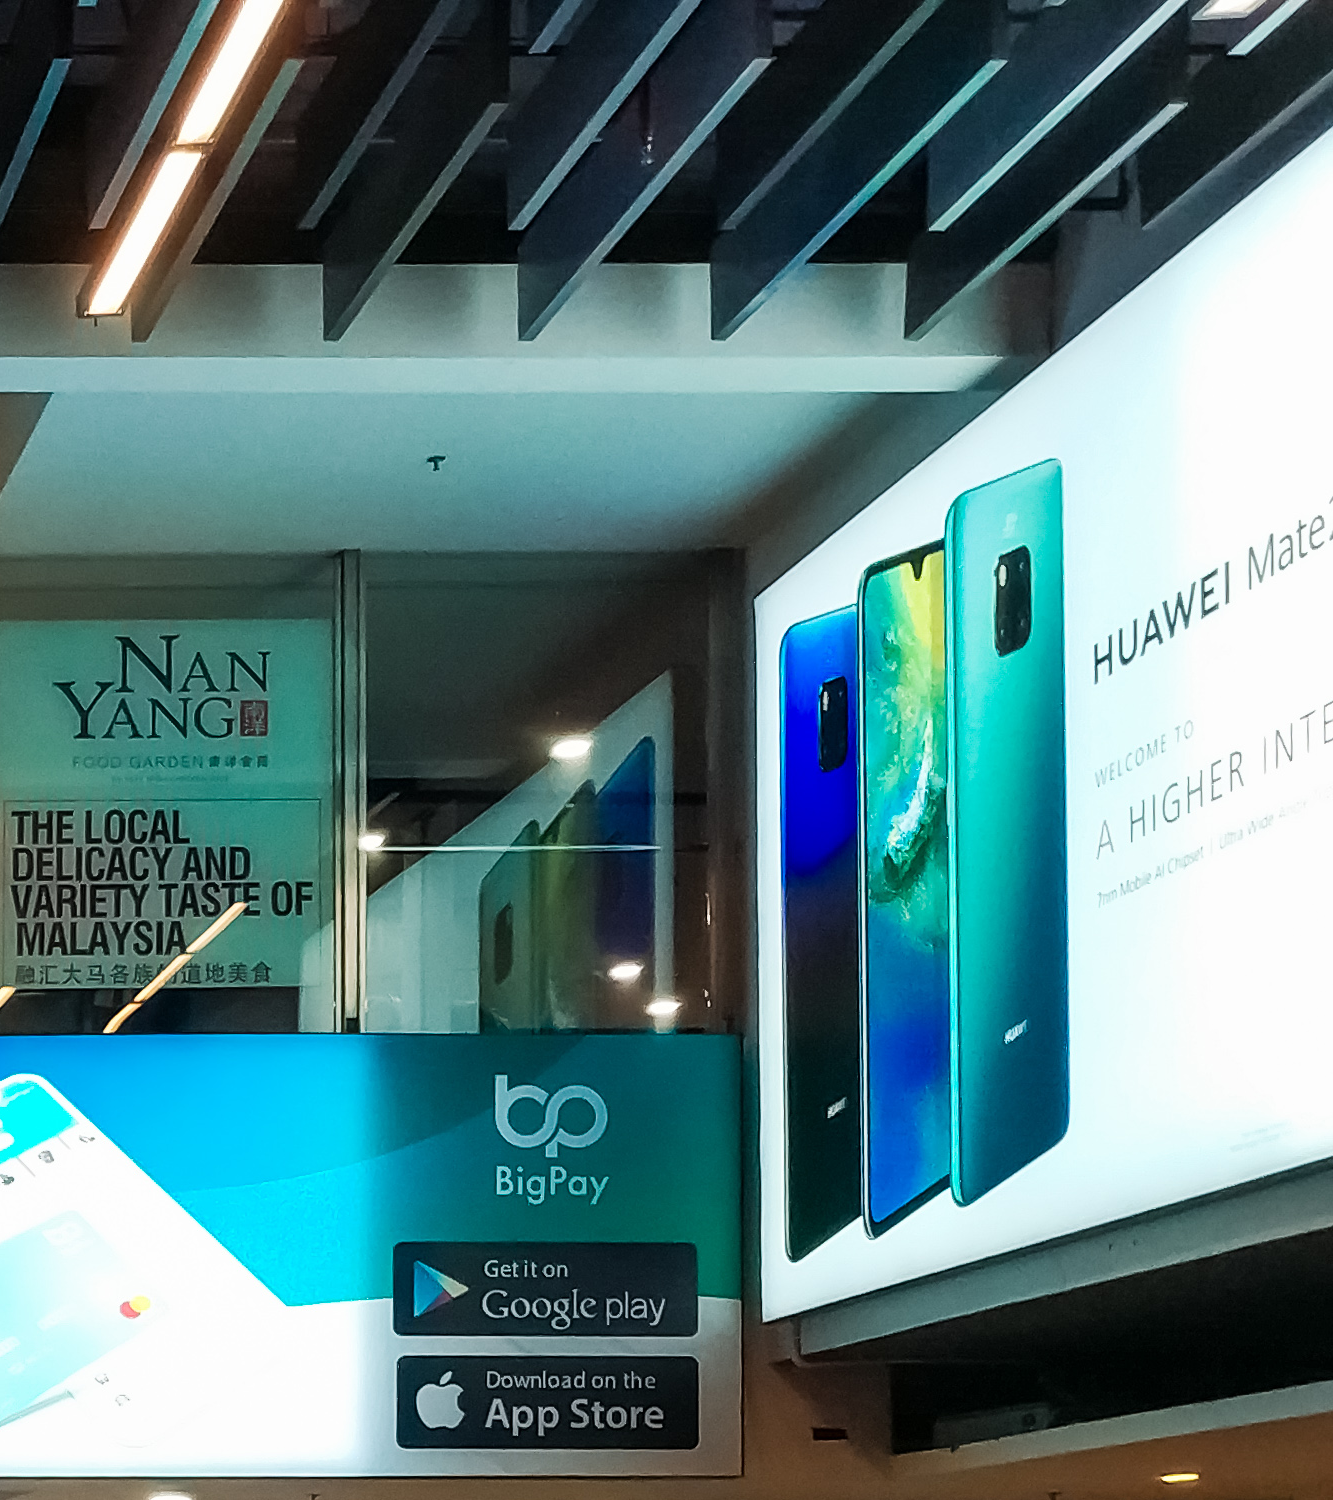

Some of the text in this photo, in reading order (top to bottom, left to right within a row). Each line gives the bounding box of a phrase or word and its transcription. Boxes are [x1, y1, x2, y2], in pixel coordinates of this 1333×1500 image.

[1094, 495, 1333, 685] HUAWEI Mate
[114, 634, 271, 694] NAN
[52, 681, 236, 740] YANG
[72, 756, 121, 769] FOOD
[129, 755, 203, 769] GARDEN
[1094, 719, 1194, 787] WELCOME TO
[1096, 819, 1115, 860] A
[1130, 751, 1244, 843] HIGHER
[11, 809, 190, 845] THE LOCAL
[11, 846, 250, 883] DELICACY AND
[1120, 872, 1152, 897] Mobile
[1154, 863, 1165, 880] AI
[1167, 846, 1204, 875] Chipset
[1247, 813, 1274, 836] Wide
[11, 881, 313, 919] VARIETY TASTE OF
[16, 920, 190, 956] MALAYSIA
[496, 1165, 609, 1206] BigPay
[484, 1260, 568, 1278] Get it on
[482, 1289, 666, 1330] Google play
[486, 1370, 656, 1389] Download on the
[485, 1398, 664, 1436] App Store
